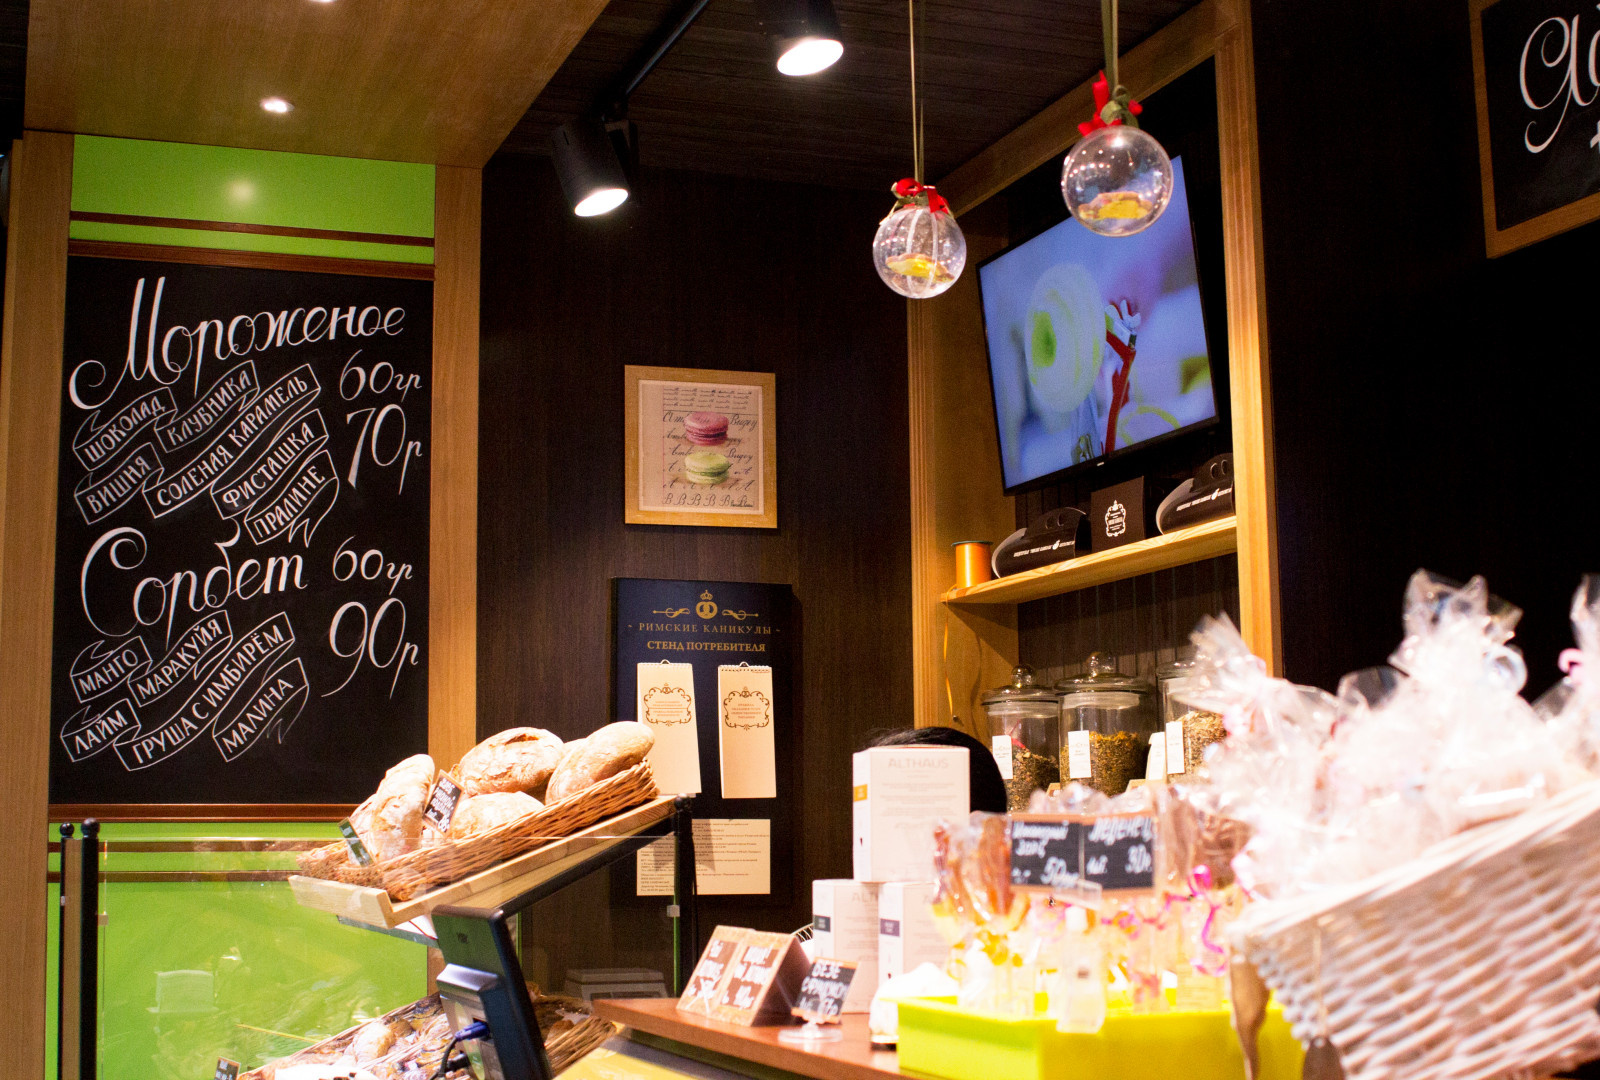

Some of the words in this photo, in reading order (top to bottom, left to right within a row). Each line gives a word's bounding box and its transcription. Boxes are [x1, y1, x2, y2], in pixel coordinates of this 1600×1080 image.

[69, 277, 405, 409] Мороженое
[84, 396, 166, 462] ШОКОЛАД
[157, 445, 228, 507] СОЛЕНАЯ
[228, 375, 308, 449] КАРАМЕЛЬ
[167, 370, 252, 446] КЛУБНИКА
[87, 454, 151, 514] ВИШНЯ
[222, 422, 315, 507] ФИСТАШКА
[253, 465, 326, 538] ПРАЛИНЕ
[81, 517, 308, 651] Сорбет
[136, 618, 223, 697] МАРАКУЙЯ
[639, 622, 698, 632] РИМСКИЕ
[703, 624, 771, 635] КАНИКУЛЫ
[647, 641, 685, 651] СТЕНД
[686, 641, 766, 652] ПОТРЕБИТЕЛЯ
[79, 649, 138, 695] МАНГО
[132, 717, 198, 764] ГРУША
[192, 702, 209, 720] С
[205, 624, 284, 706] ИМБИРЁМ
[74, 710, 127, 753] ЛАЙМ
[222, 677, 293, 753] МАЛИНА
